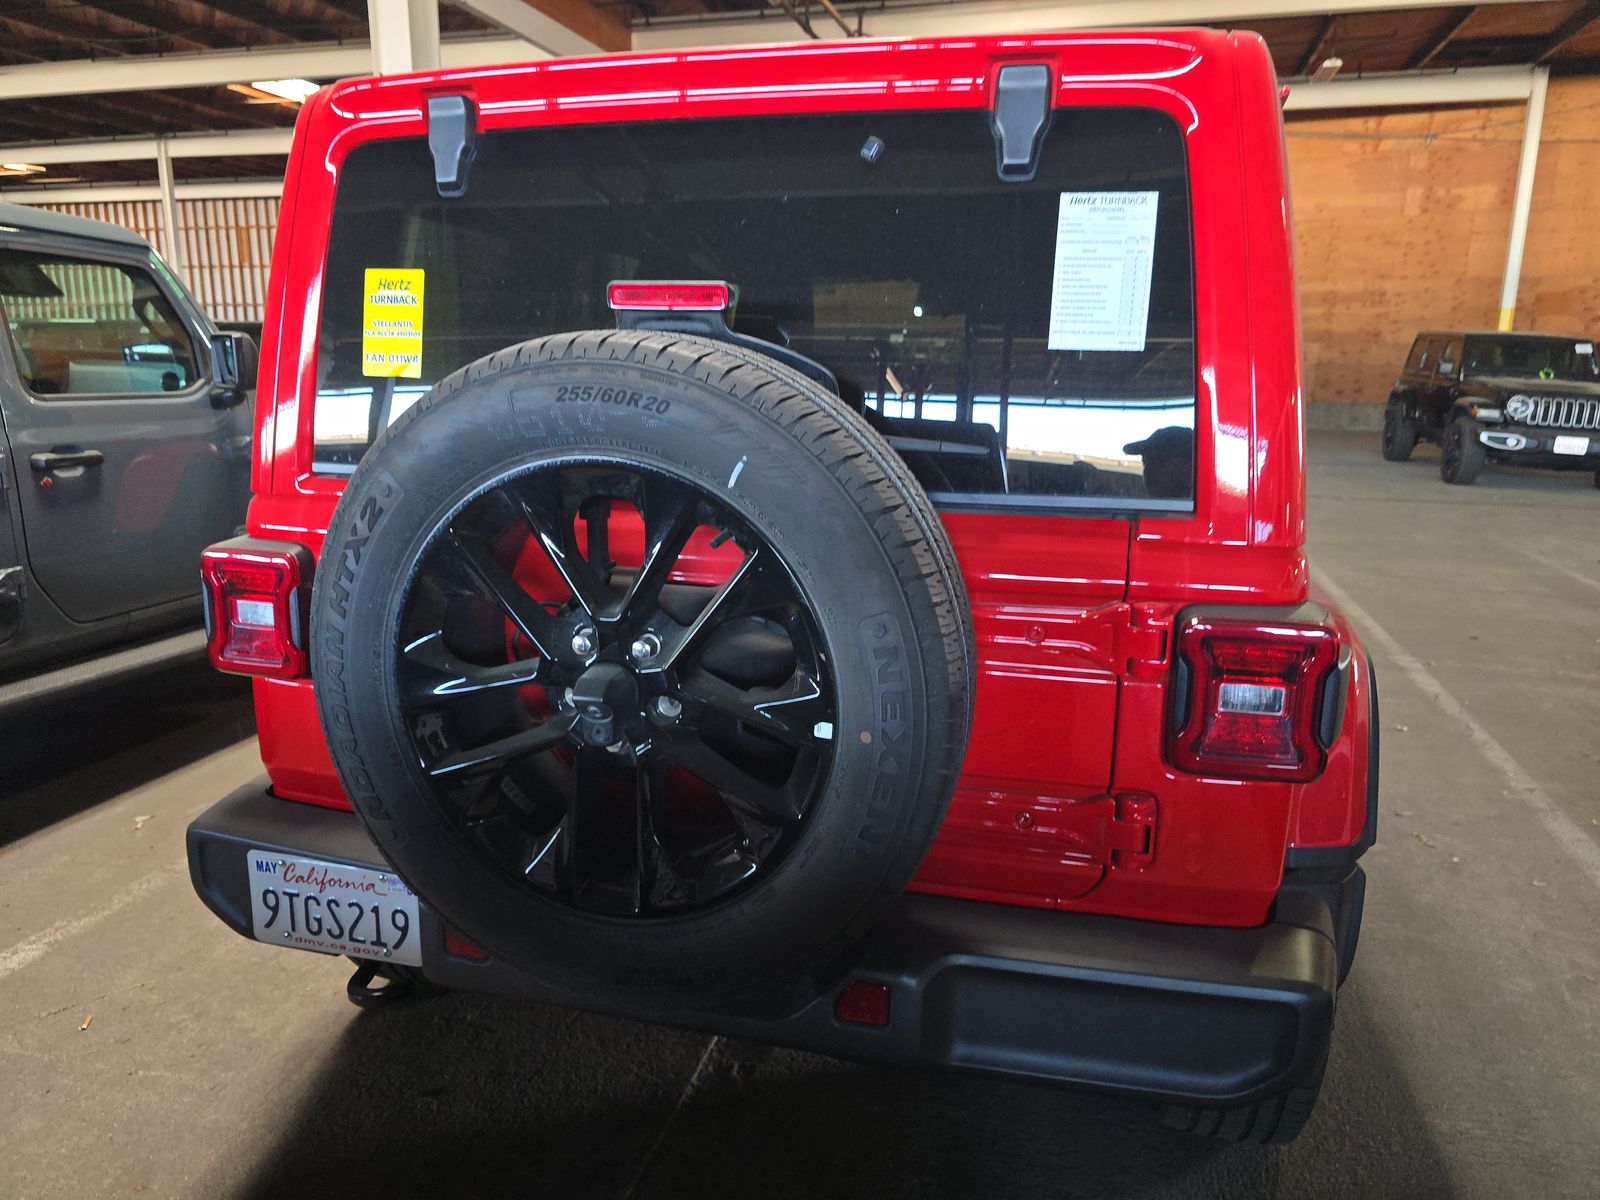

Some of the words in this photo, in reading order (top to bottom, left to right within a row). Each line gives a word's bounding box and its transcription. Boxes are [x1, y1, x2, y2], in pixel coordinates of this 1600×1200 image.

[1069, 195, 1098, 206] Hertz
[377, 278, 412, 291] Hertz
[369, 294, 418, 305] TURNBACK
[372, 319, 413, 328] STELLANTIS
[366, 352, 385, 363] FAN
[555, 385, 671, 415] 255/60R20
[255, 860, 278, 875] MAY
[283, 862, 388, 897] California
[262, 887, 410, 951] 9TGS219
[296, 936, 381, 954] dmv.ca.gov
